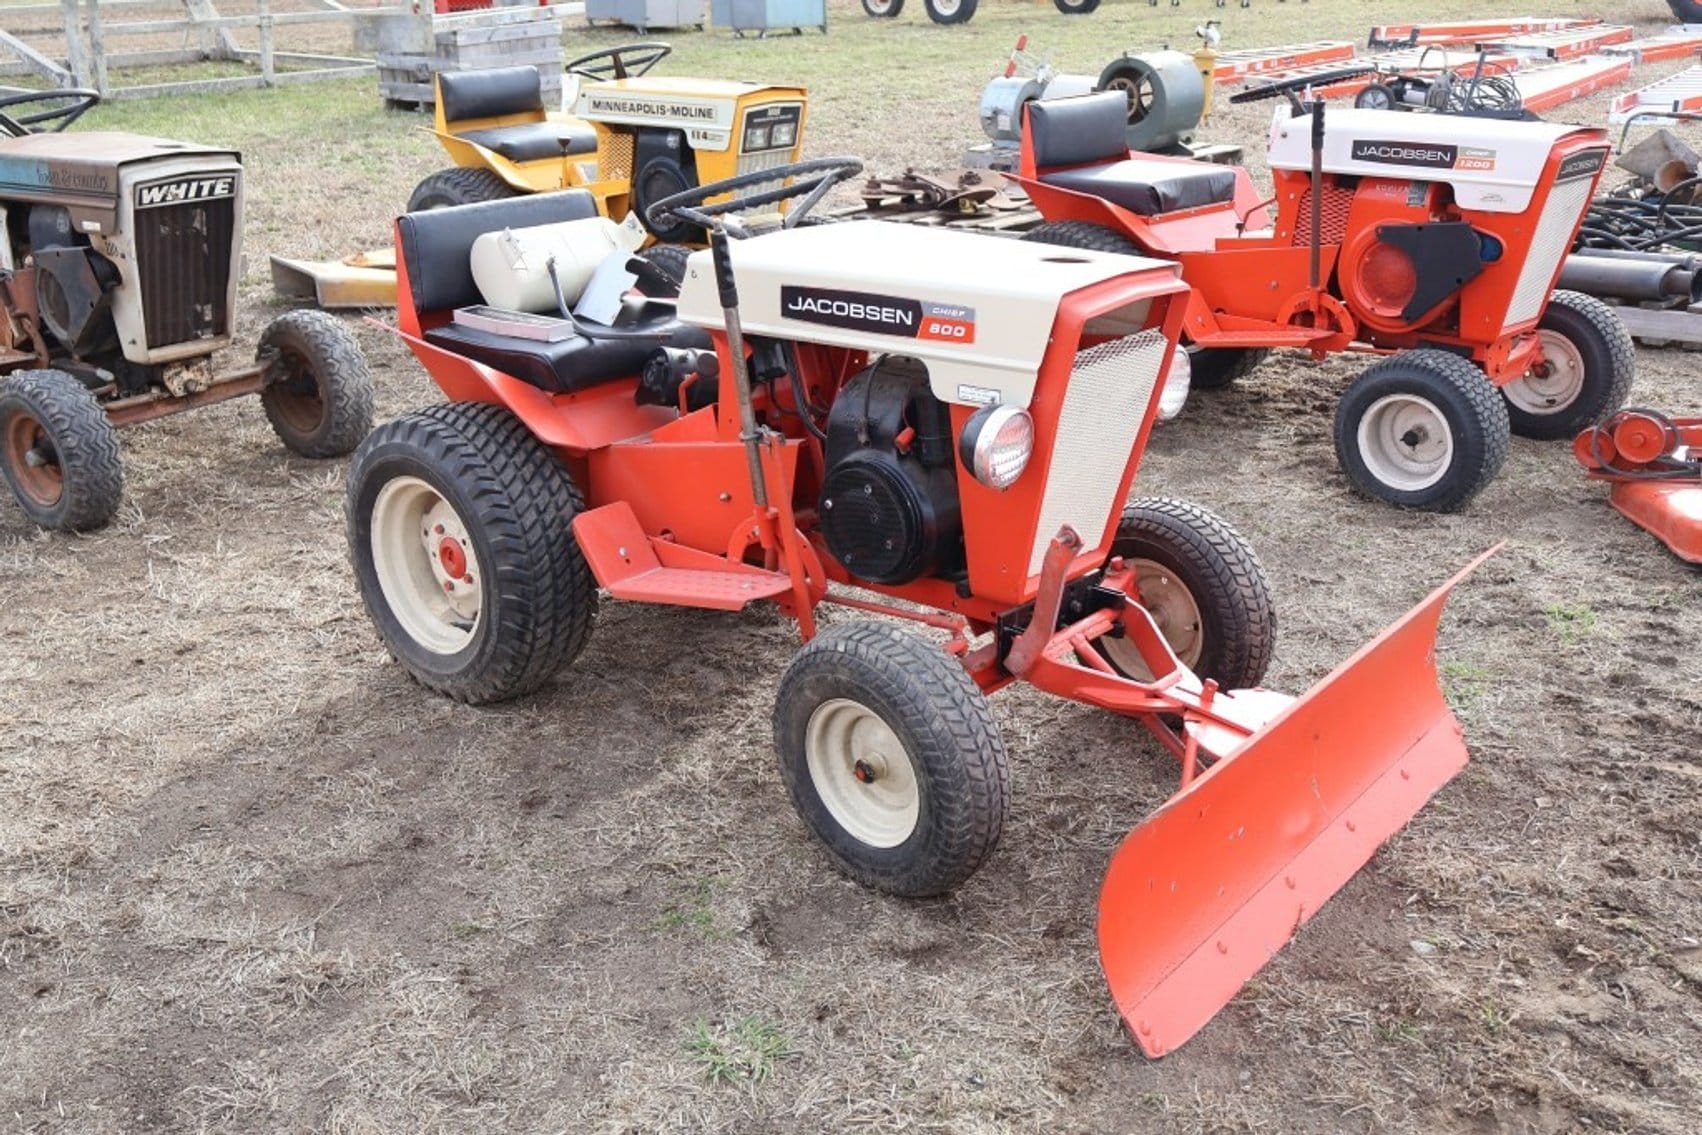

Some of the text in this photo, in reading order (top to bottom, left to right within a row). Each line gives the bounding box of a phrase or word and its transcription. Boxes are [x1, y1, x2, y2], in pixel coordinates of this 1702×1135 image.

[1357, 146, 1450, 161] JACOBSEN
[1460, 160, 1491, 168] 1200
[142, 178, 232, 204] WHITE
[788, 297, 912, 325] JACOBSEN
[932, 307, 965, 317] CHIEF
[929, 323, 965, 337] 800
